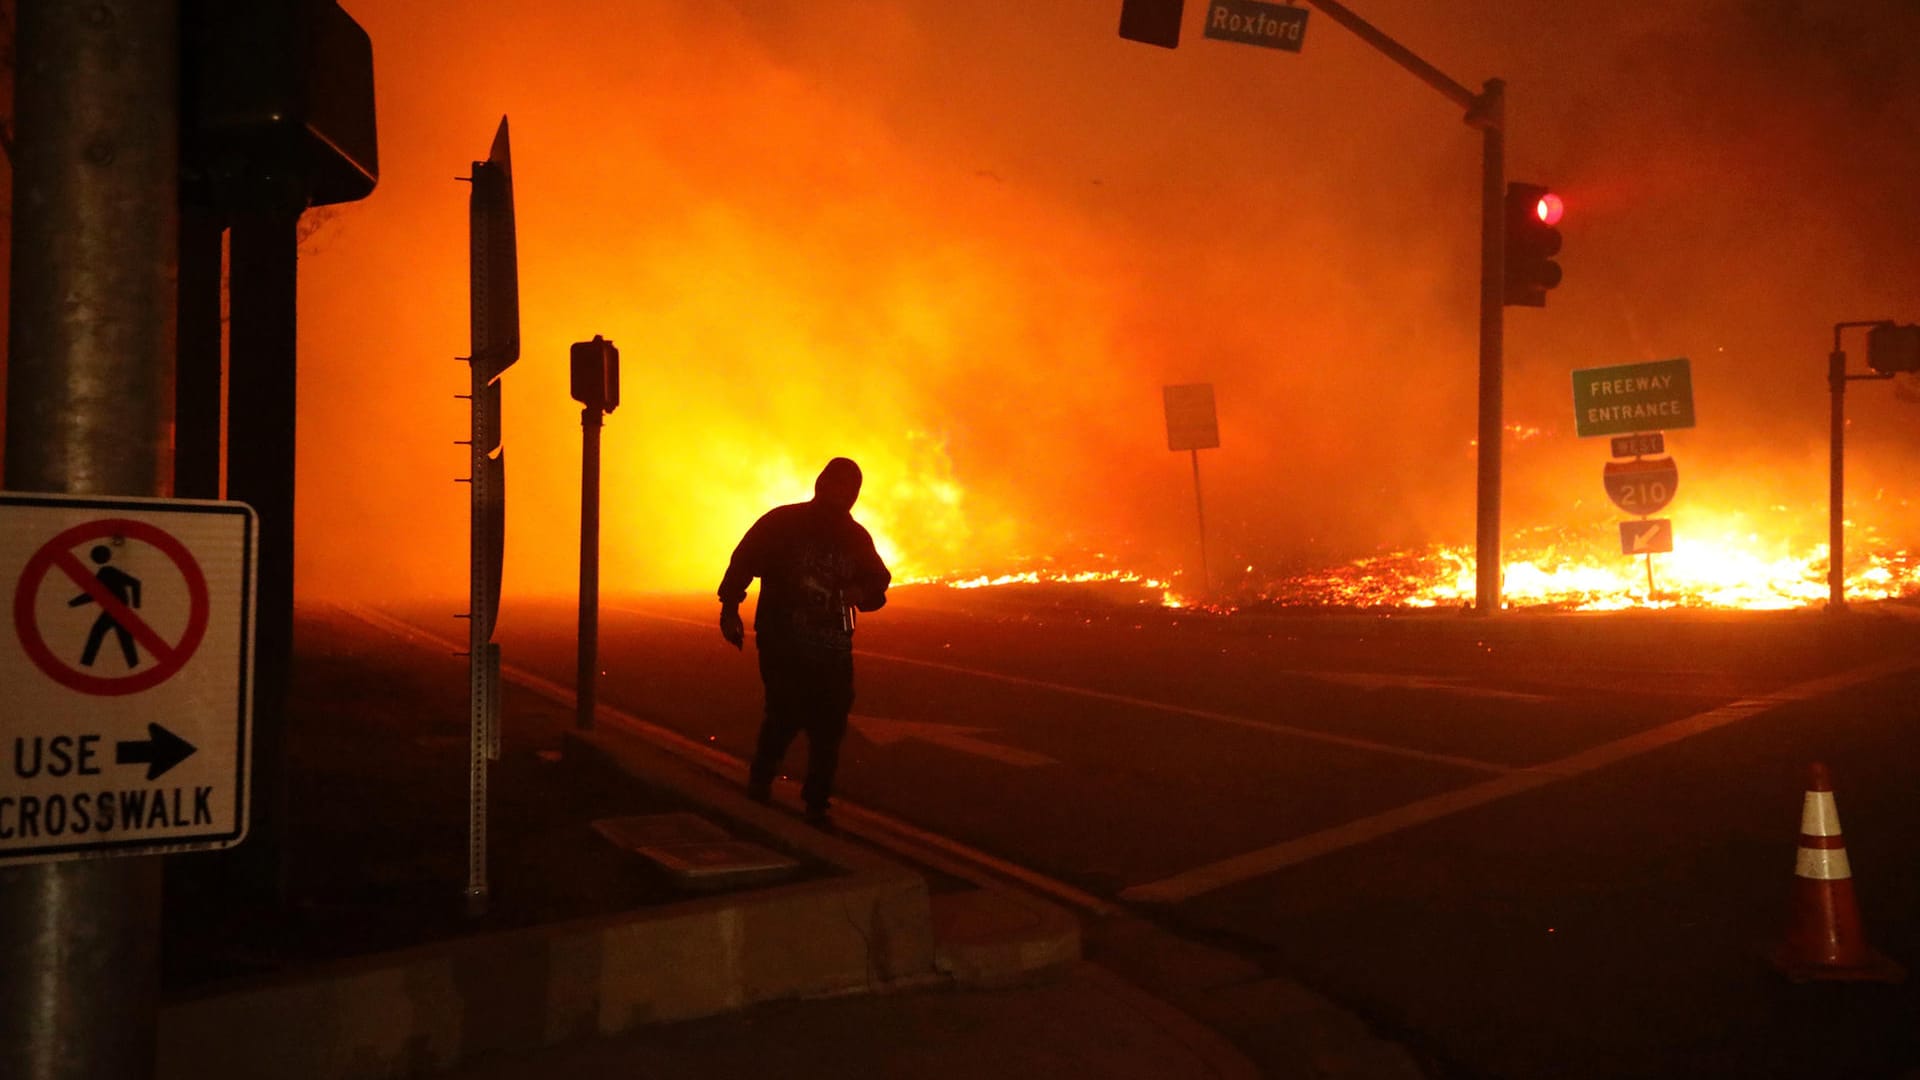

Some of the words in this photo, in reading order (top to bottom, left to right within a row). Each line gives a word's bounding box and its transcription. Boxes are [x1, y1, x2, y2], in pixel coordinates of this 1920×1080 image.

[1212, 6, 1301, 41] Roxford
[1589, 375, 1672, 396] FREEWAY
[1588, 400, 1681, 423] ENTRANCE
[1620, 482, 1666, 506] 210
[15, 735, 101, 778] USE
[0, 786, 213, 839] CROSSWALK
